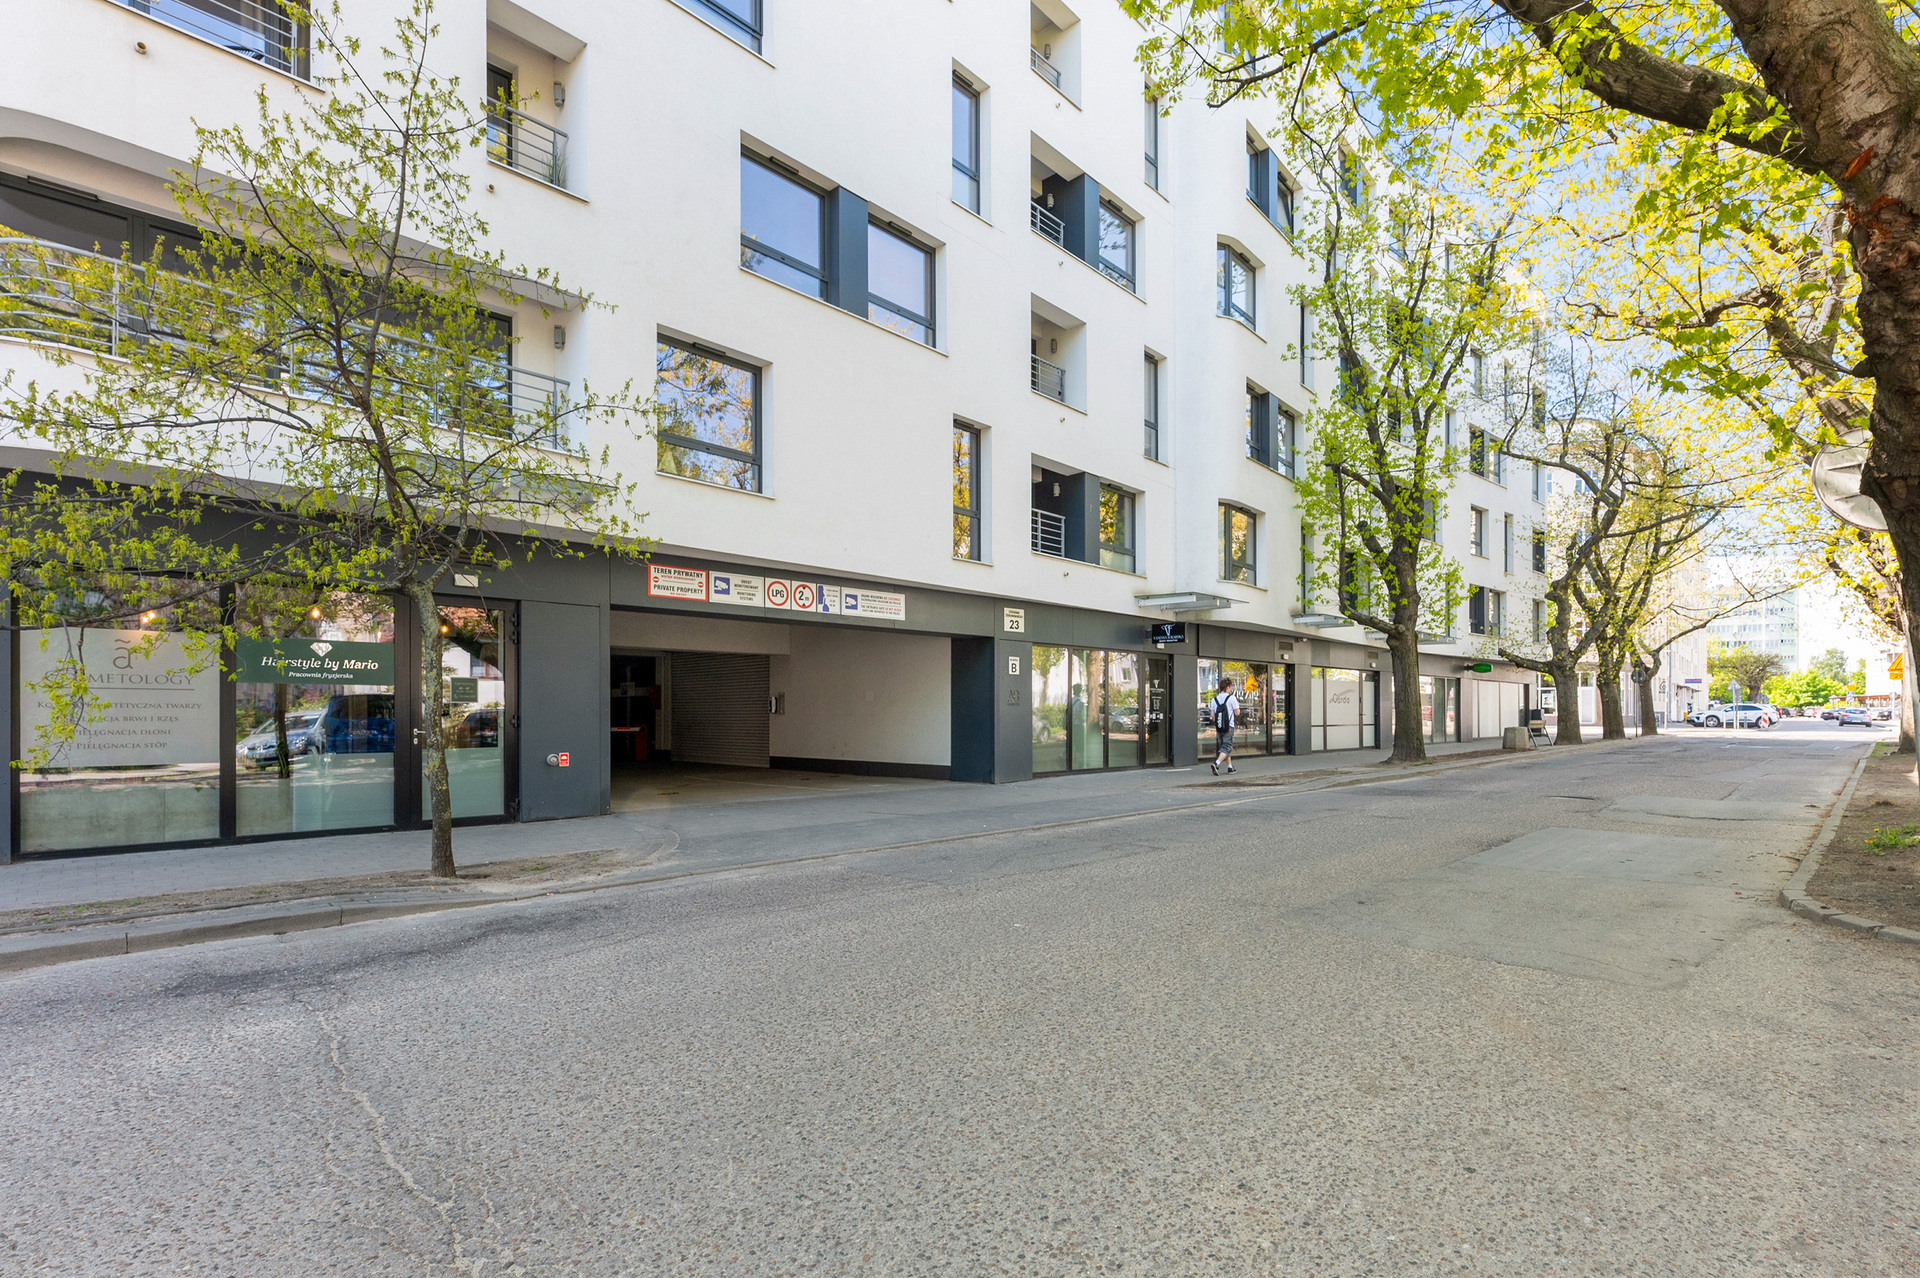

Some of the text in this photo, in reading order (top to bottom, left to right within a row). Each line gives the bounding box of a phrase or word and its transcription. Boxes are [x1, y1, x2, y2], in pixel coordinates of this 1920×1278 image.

[654, 567, 704, 578] TEREN PRYWATNY
[654, 584, 703, 595] PRIVATE PROPERTY
[772, 589, 785, 598] LPG
[798, 590, 804, 601] 2
[1010, 620, 1020, 630] 23
[261, 656, 379, 671] Harstyle by Mario
[1012, 663, 1017, 673] B
